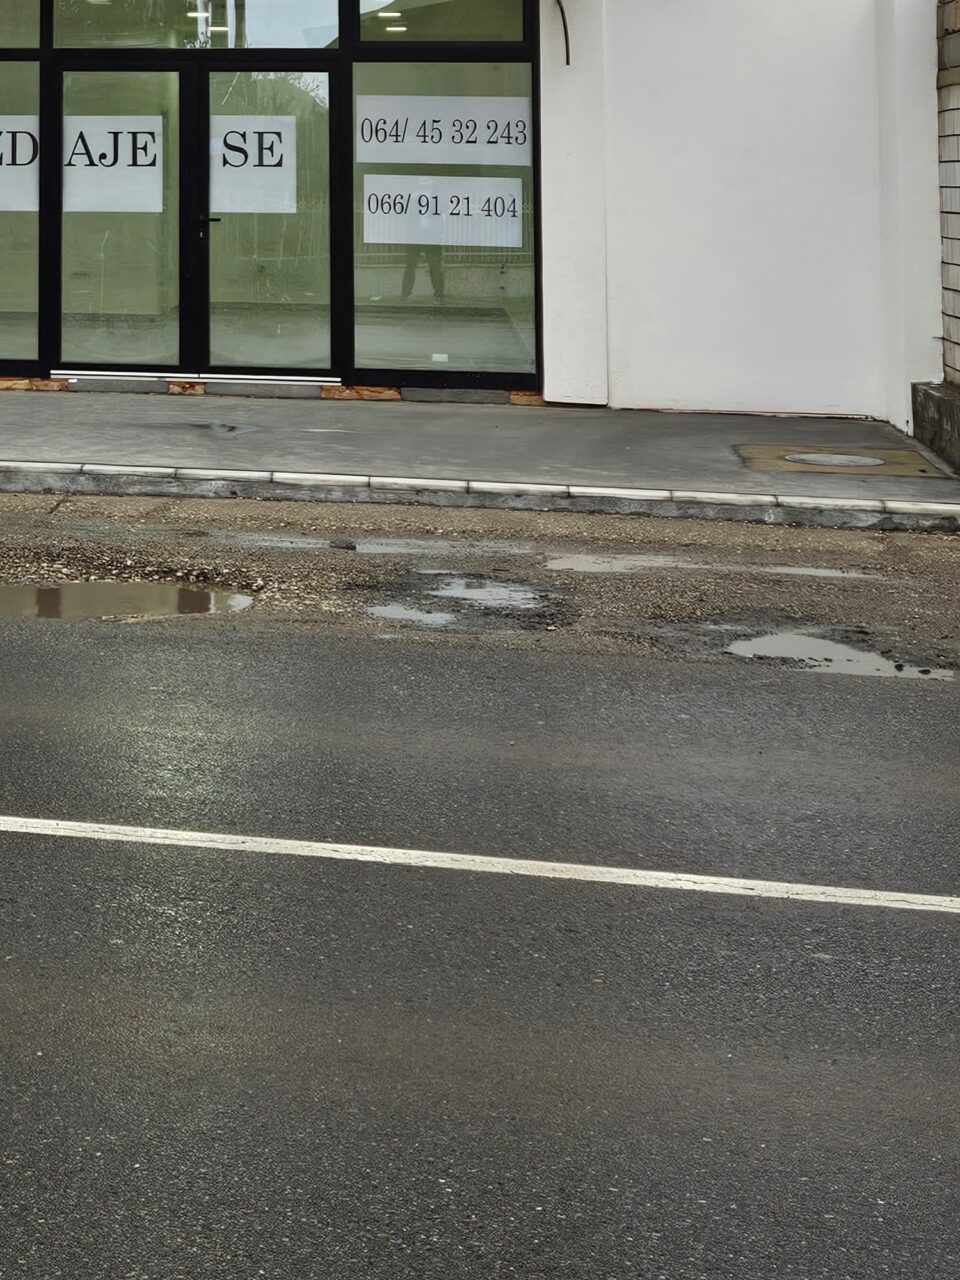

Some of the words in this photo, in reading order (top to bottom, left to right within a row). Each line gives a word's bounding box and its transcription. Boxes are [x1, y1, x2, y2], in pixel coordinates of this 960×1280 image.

[361, 117, 408, 143] 064/
[416, 119, 442, 144] 45
[451, 119, 477, 144] 32
[486, 120, 527, 145] 243
[221, 130, 283, 169] SE
[367, 192, 411, 214] 066/
[418, 194, 440, 216] 91
[449, 195, 472, 216] 21
[481, 197, 518, 218] 404
